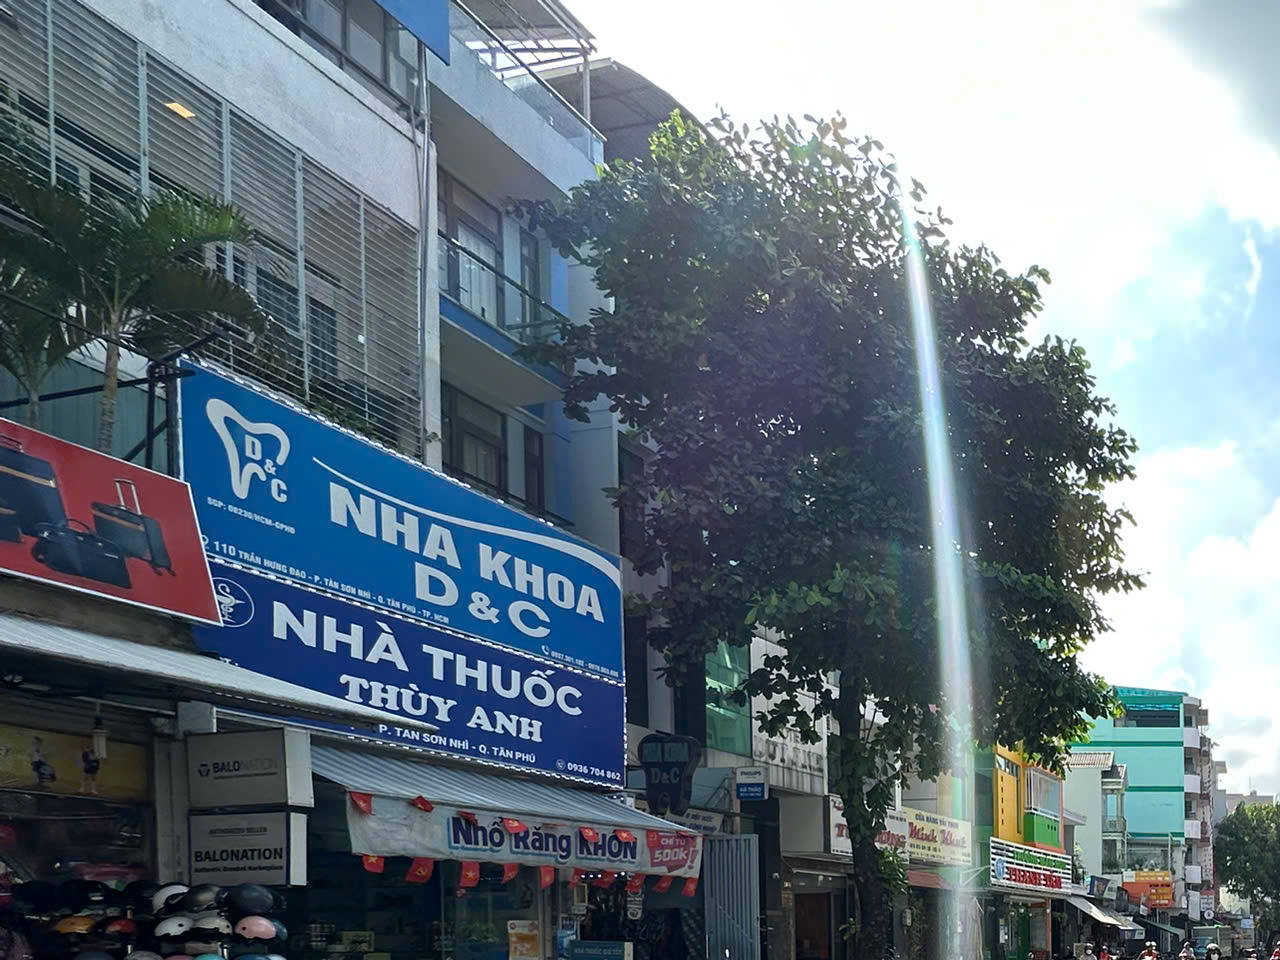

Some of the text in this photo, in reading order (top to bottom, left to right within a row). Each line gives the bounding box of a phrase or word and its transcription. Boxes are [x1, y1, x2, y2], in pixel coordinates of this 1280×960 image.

[329, 481, 604, 623] NHA KHOA
[415, 562, 551, 638] D & C
[273, 600, 582, 716] NHÀ THUỐC
[339, 674, 543, 743] THÙY ANH
[379, 724, 391, 735] P.
[423, 732, 446, 746] SƠN
[450, 738, 469, 751] NHÌ
[479, 744, 490, 756] Q.
[492, 746, 513, 760] TÂN
[515, 750, 536, 763] PHÚ
[567, 762, 621, 780] 0936 704 862
[194, 847, 283, 863] BALONATION
[452, 813, 505, 847] Nhổ
[513, 825, 571, 861] Răng
